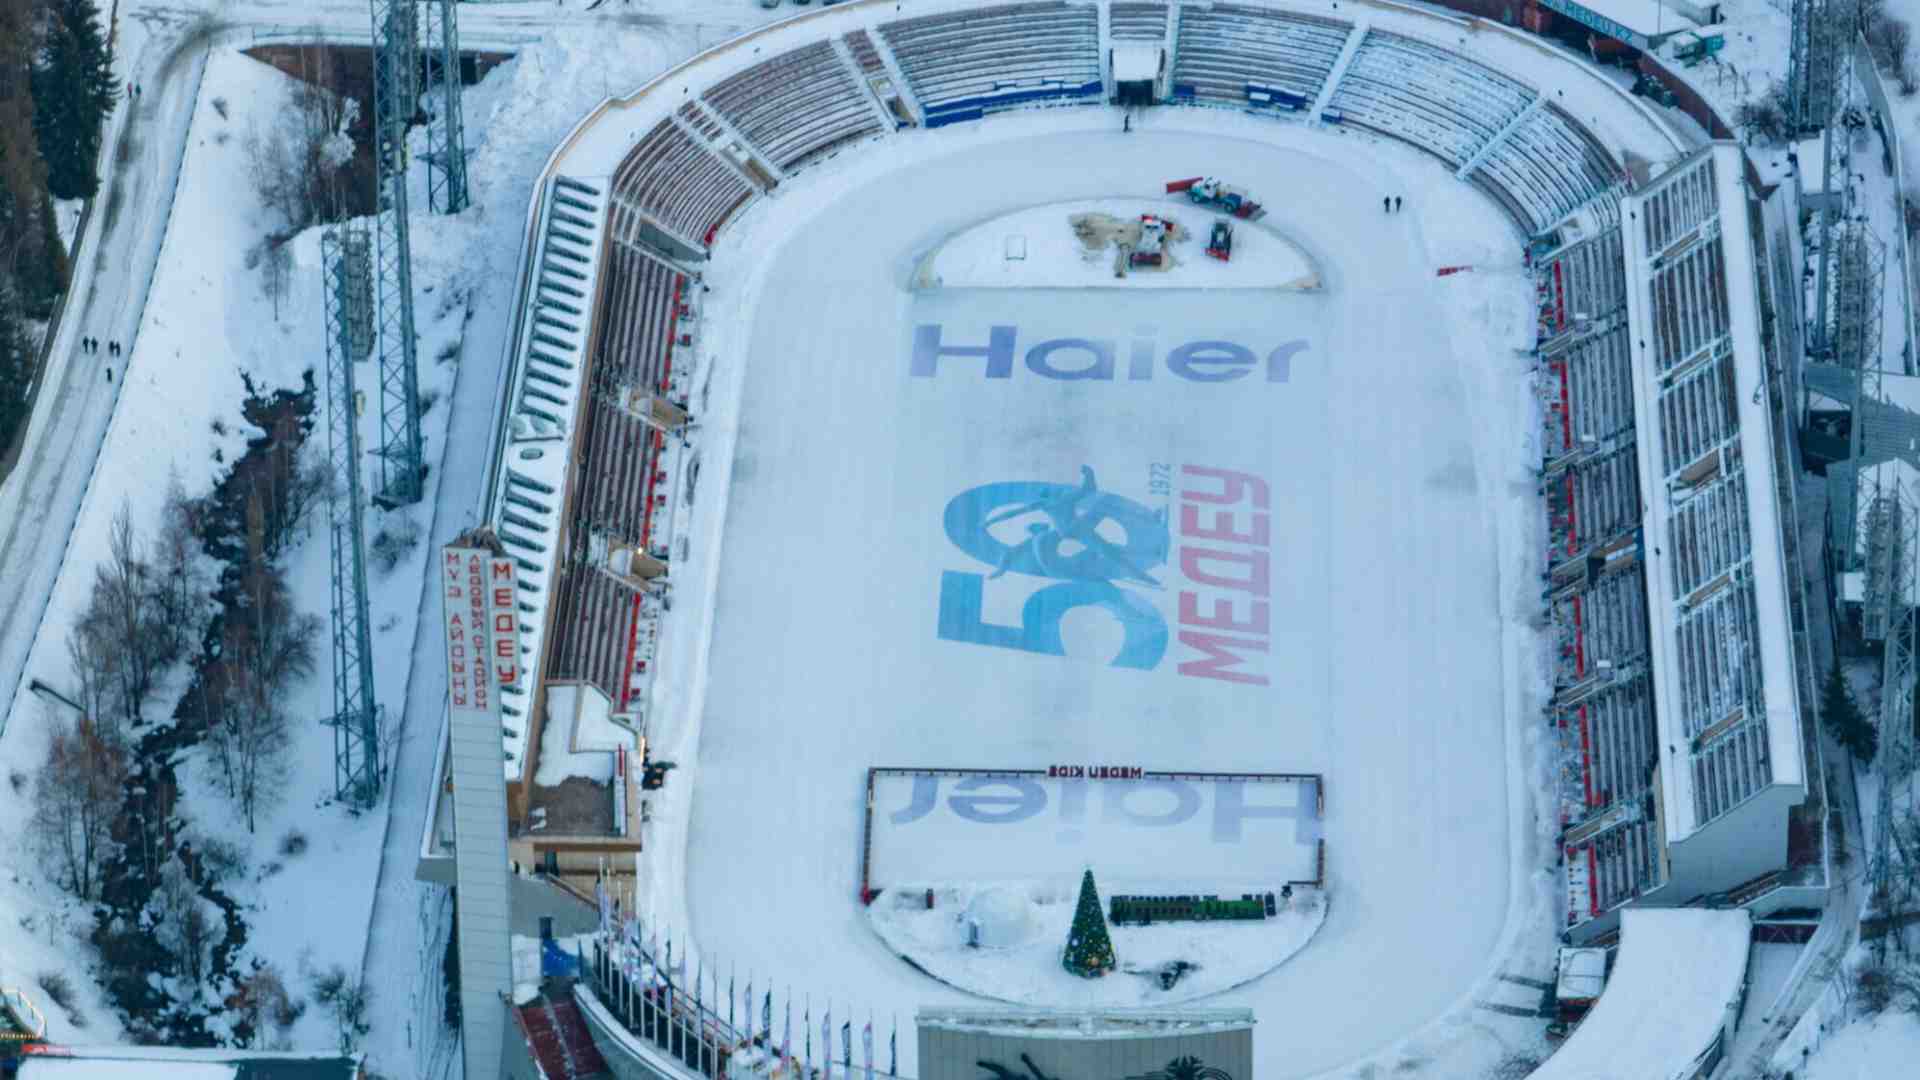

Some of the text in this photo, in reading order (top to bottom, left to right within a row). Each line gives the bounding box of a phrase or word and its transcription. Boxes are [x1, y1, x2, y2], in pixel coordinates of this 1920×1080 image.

[909, 324, 1311, 383] Haier
[1150, 462, 1171, 495] 1972
[1177, 463, 1271, 687] МЕДЕУ
[492, 562, 516, 683] МЕДЕУ
[889, 774, 1320, 845] Haier
